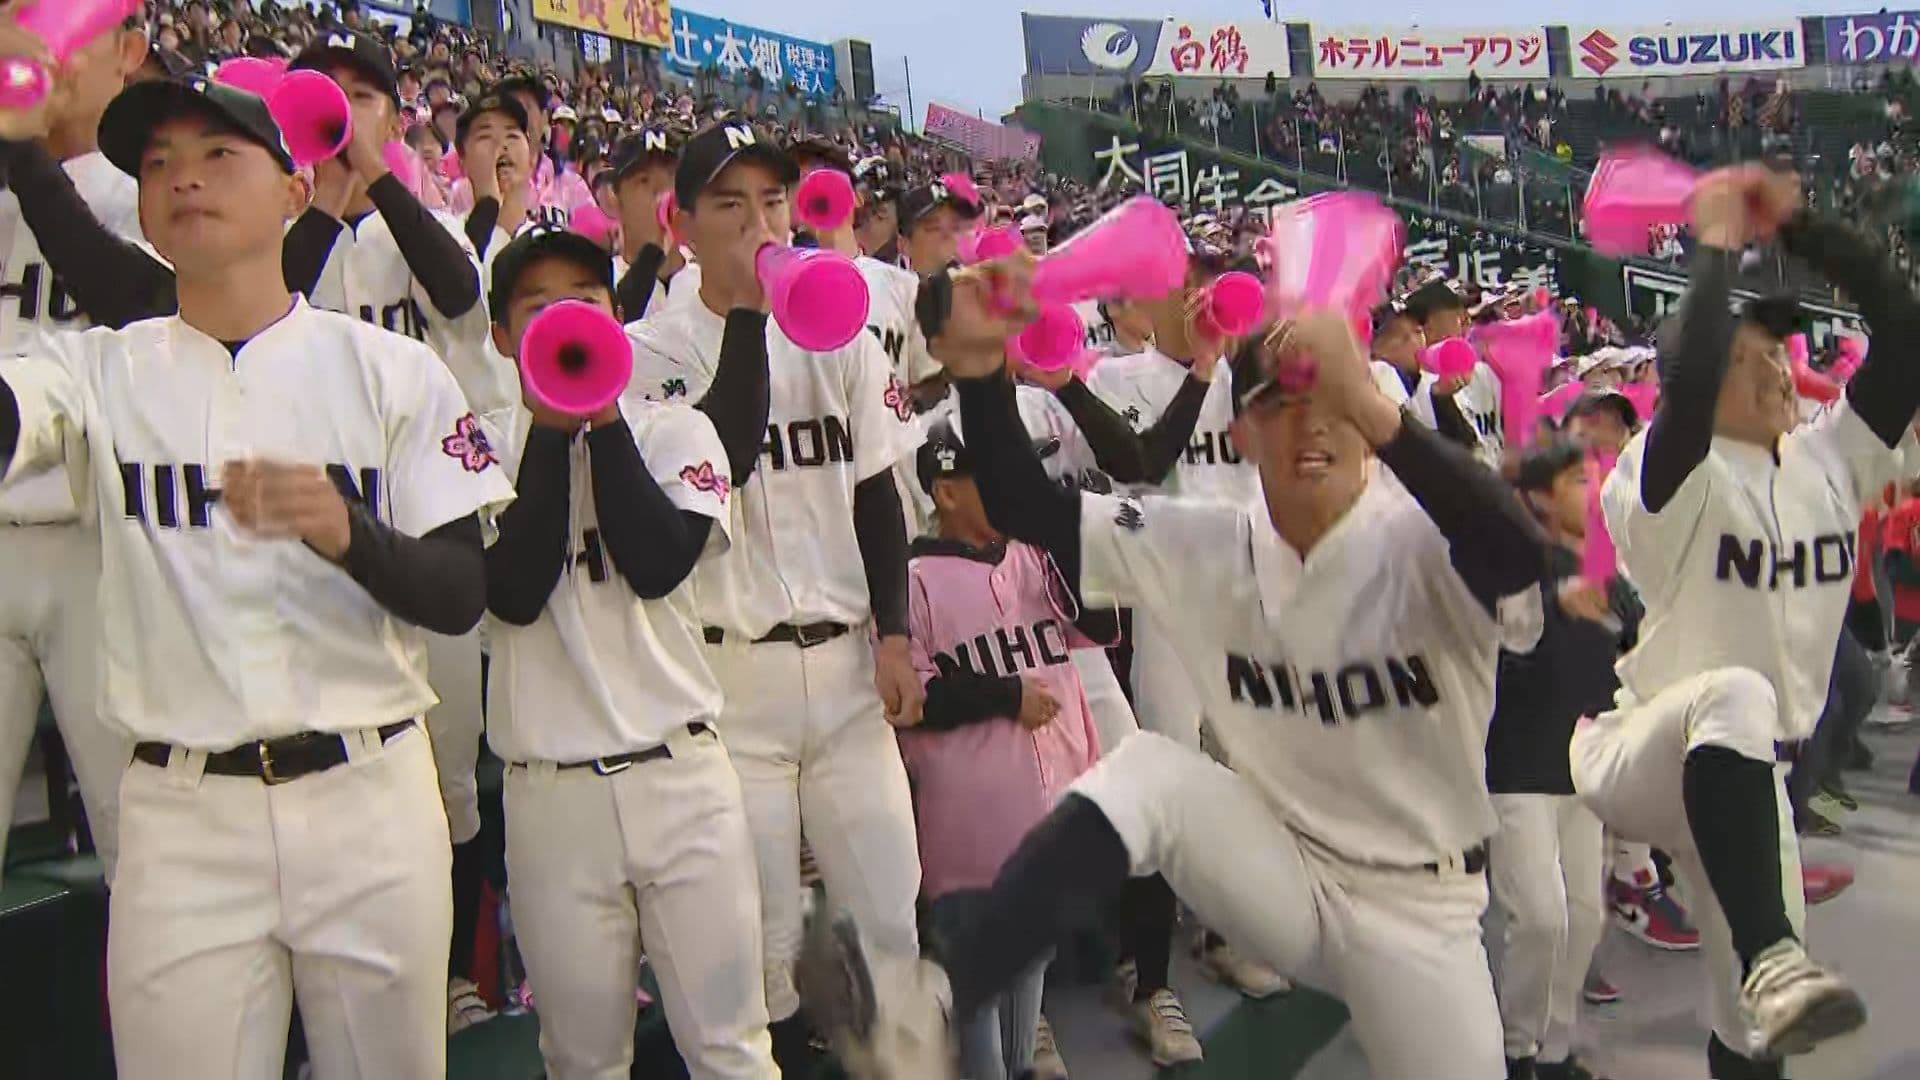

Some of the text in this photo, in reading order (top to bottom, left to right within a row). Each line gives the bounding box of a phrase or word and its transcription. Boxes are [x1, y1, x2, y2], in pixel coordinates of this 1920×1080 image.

[1170, 25, 1249, 73] 白鶴
[1319, 35, 1543, 69] ホテルニューアワジ
[1629, 31, 1794, 66] SUZUKI
[645, 129, 667, 150] N
[724, 125, 756, 149] N
[1226, 653, 1438, 726] NIHON
